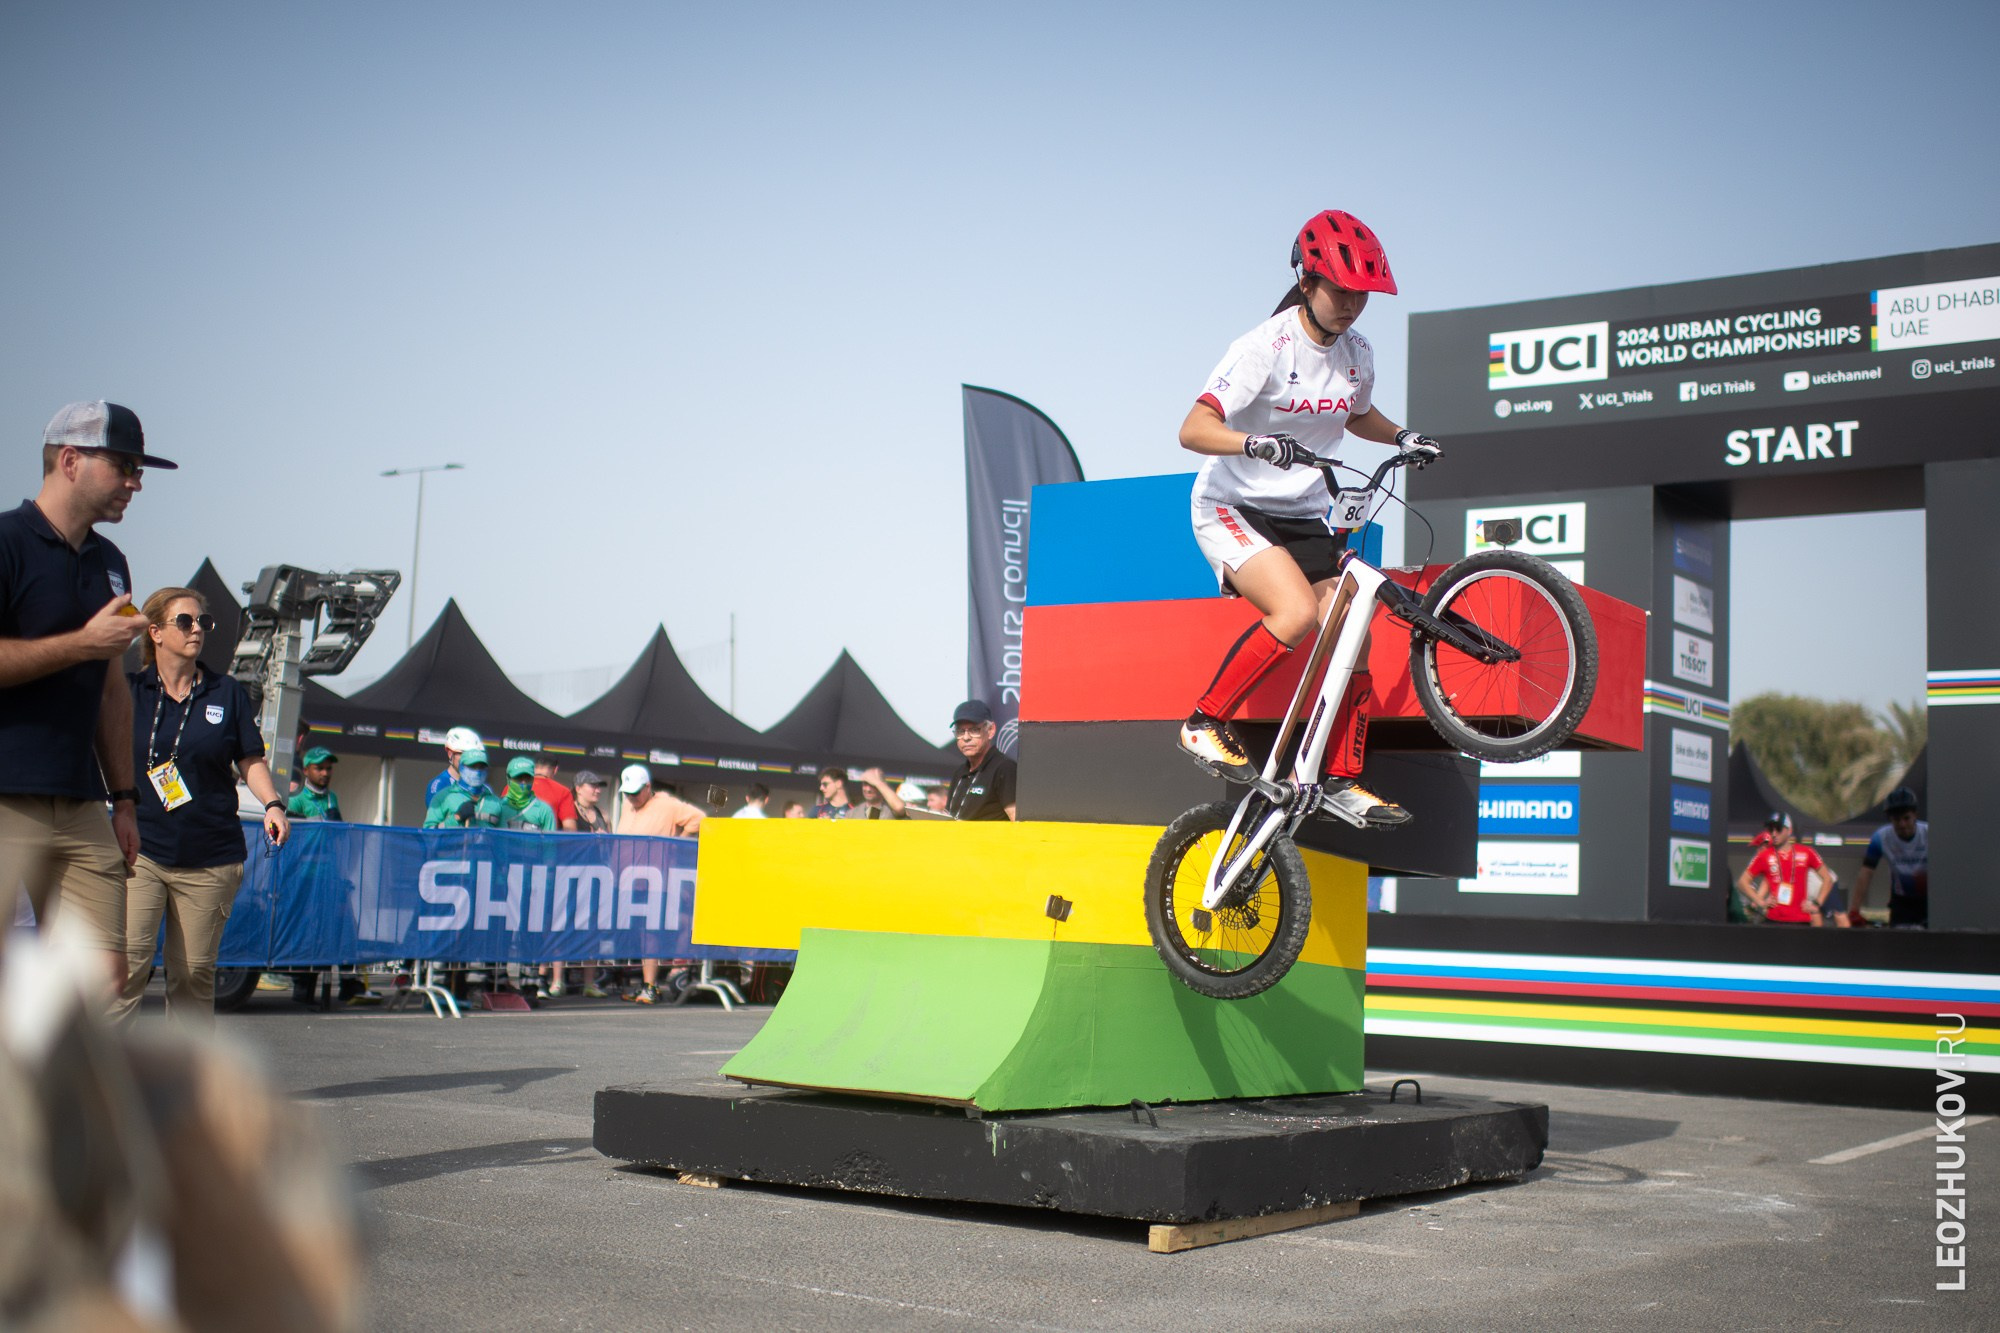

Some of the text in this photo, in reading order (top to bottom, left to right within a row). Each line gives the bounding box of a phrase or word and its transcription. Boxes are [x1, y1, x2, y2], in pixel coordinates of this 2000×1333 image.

[1889, 288, 2000, 317] ABU DHABI
[1616, 307, 1823, 348] 2024 URBAN CYCLING
[1890, 318, 1930, 339] UAE
[1510, 334, 1598, 376] UCI
[1616, 325, 1862, 368] WORLD CHAMPIONSHIPS
[1812, 366, 1882, 386] ucichannel
[1934, 356, 1996, 376] uci_trials
[1700, 378, 1756, 396] UCI Trials
[1513, 400, 1553, 414] uci.org
[1596, 390, 1654, 408] UCI_Trials
[1725, 420, 1860, 467] START
[1344, 505, 1365, 522] 8C
[1494, 513, 1568, 545] CI
[1393, 603, 1465, 648] MAESTRO
[1680, 653, 1708, 674] TISSOT
[1684, 696, 1702, 718] UCI
[502, 738, 541, 752] BELGIUM
[717, 758, 757, 772] AUSTRALIA
[1673, 799, 1709, 821] SHIMANO
